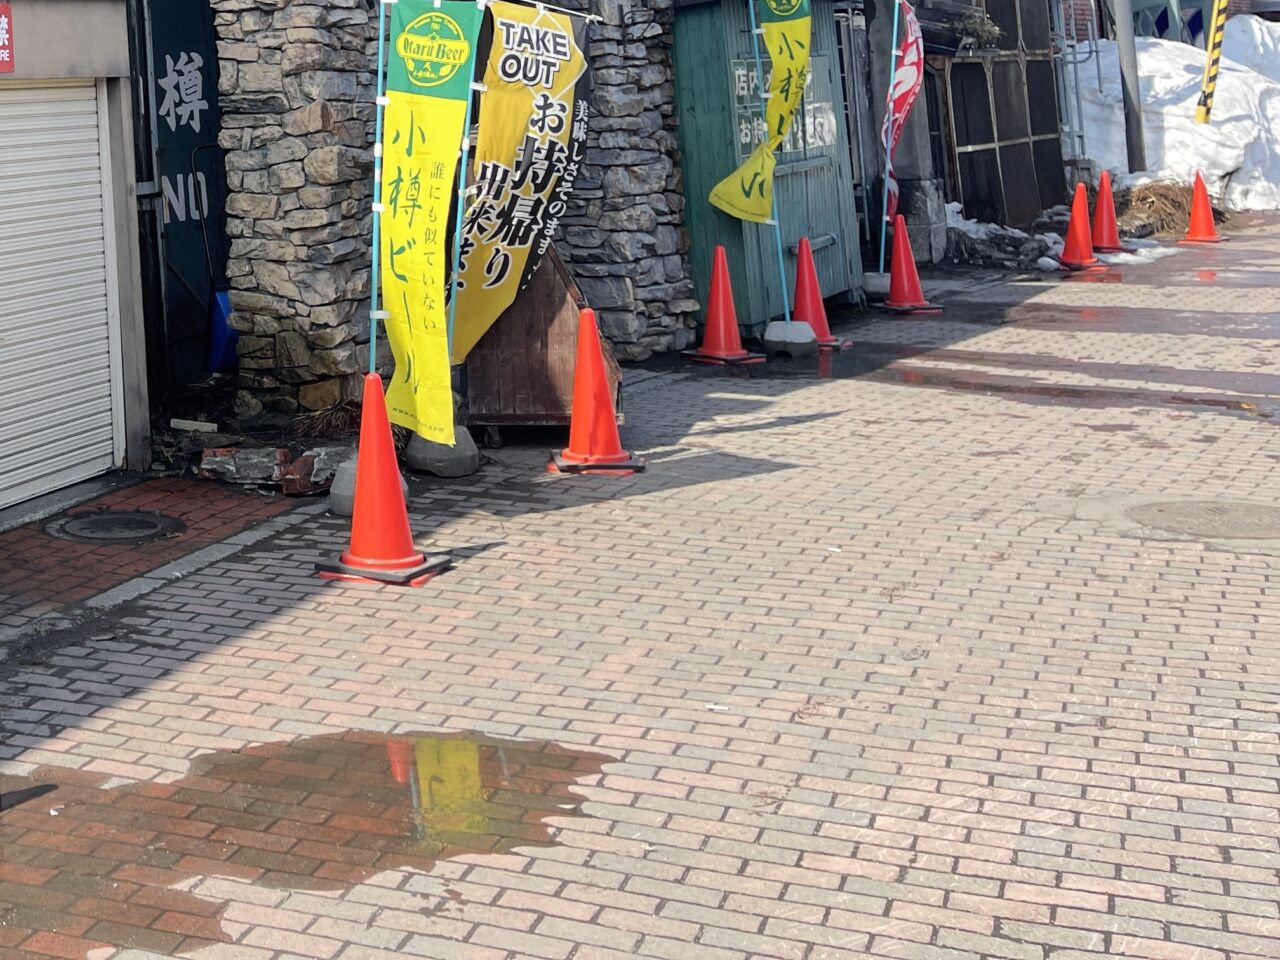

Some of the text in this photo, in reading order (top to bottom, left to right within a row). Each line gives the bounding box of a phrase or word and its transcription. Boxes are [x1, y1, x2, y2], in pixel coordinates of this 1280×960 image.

[436, 43, 465, 61] Beer
[499, 20, 570, 60] TAKE
[500, 51, 558, 88] OUT
[388, 110, 426, 394] 小樽ビール
[423, 161, 445, 330] 誰にも似ていない
